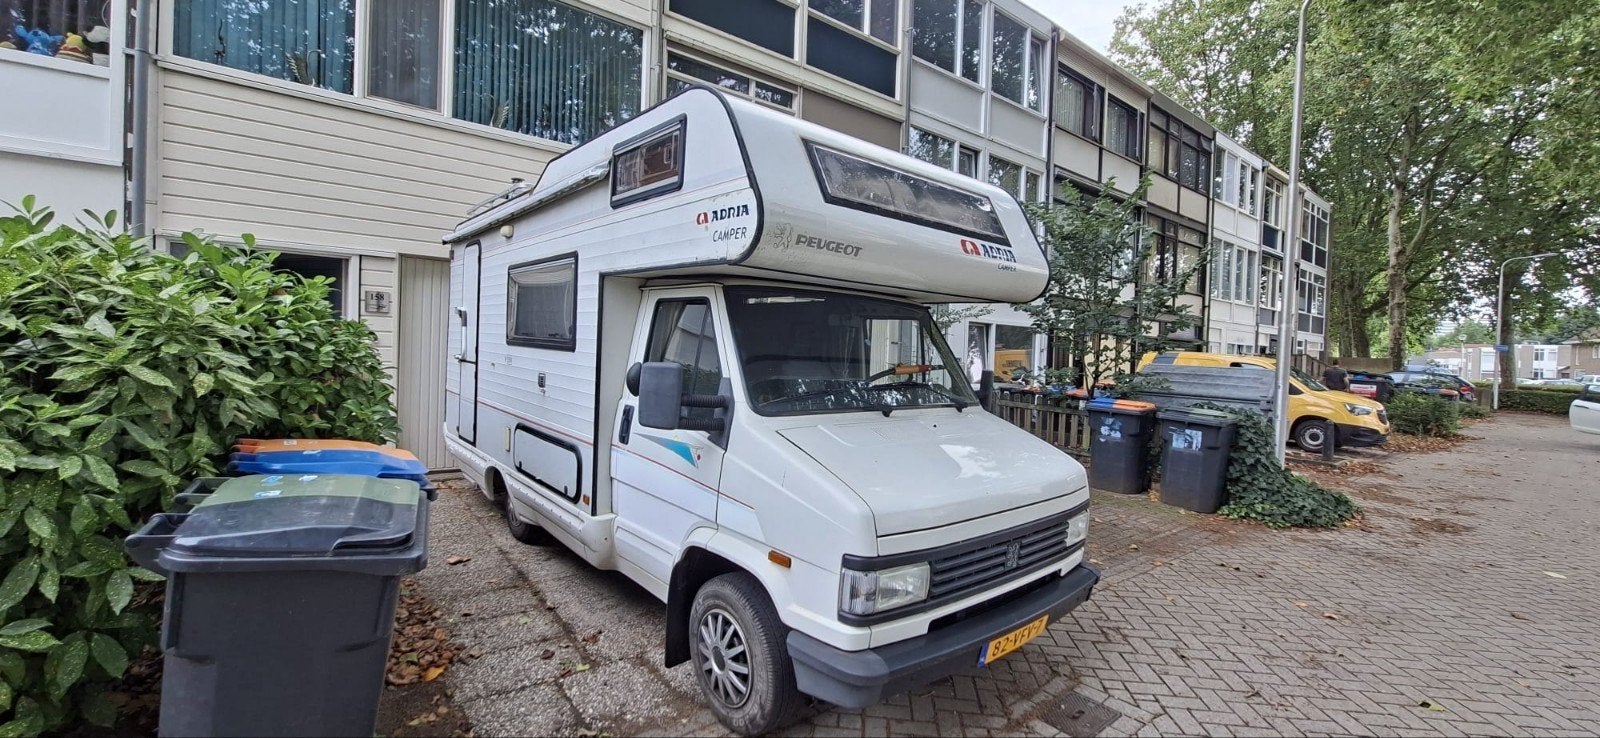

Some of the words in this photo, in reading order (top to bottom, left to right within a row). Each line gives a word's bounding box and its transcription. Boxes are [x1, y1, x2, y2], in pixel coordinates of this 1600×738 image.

[711, 204, 750, 222] ADRIA
[712, 226, 748, 242] CAMPER
[794, 234, 863, 257] PEUGEOT
[980, 243, 1017, 263] ADRIA
[992, 618, 1045, 657] 82-VFV-7
